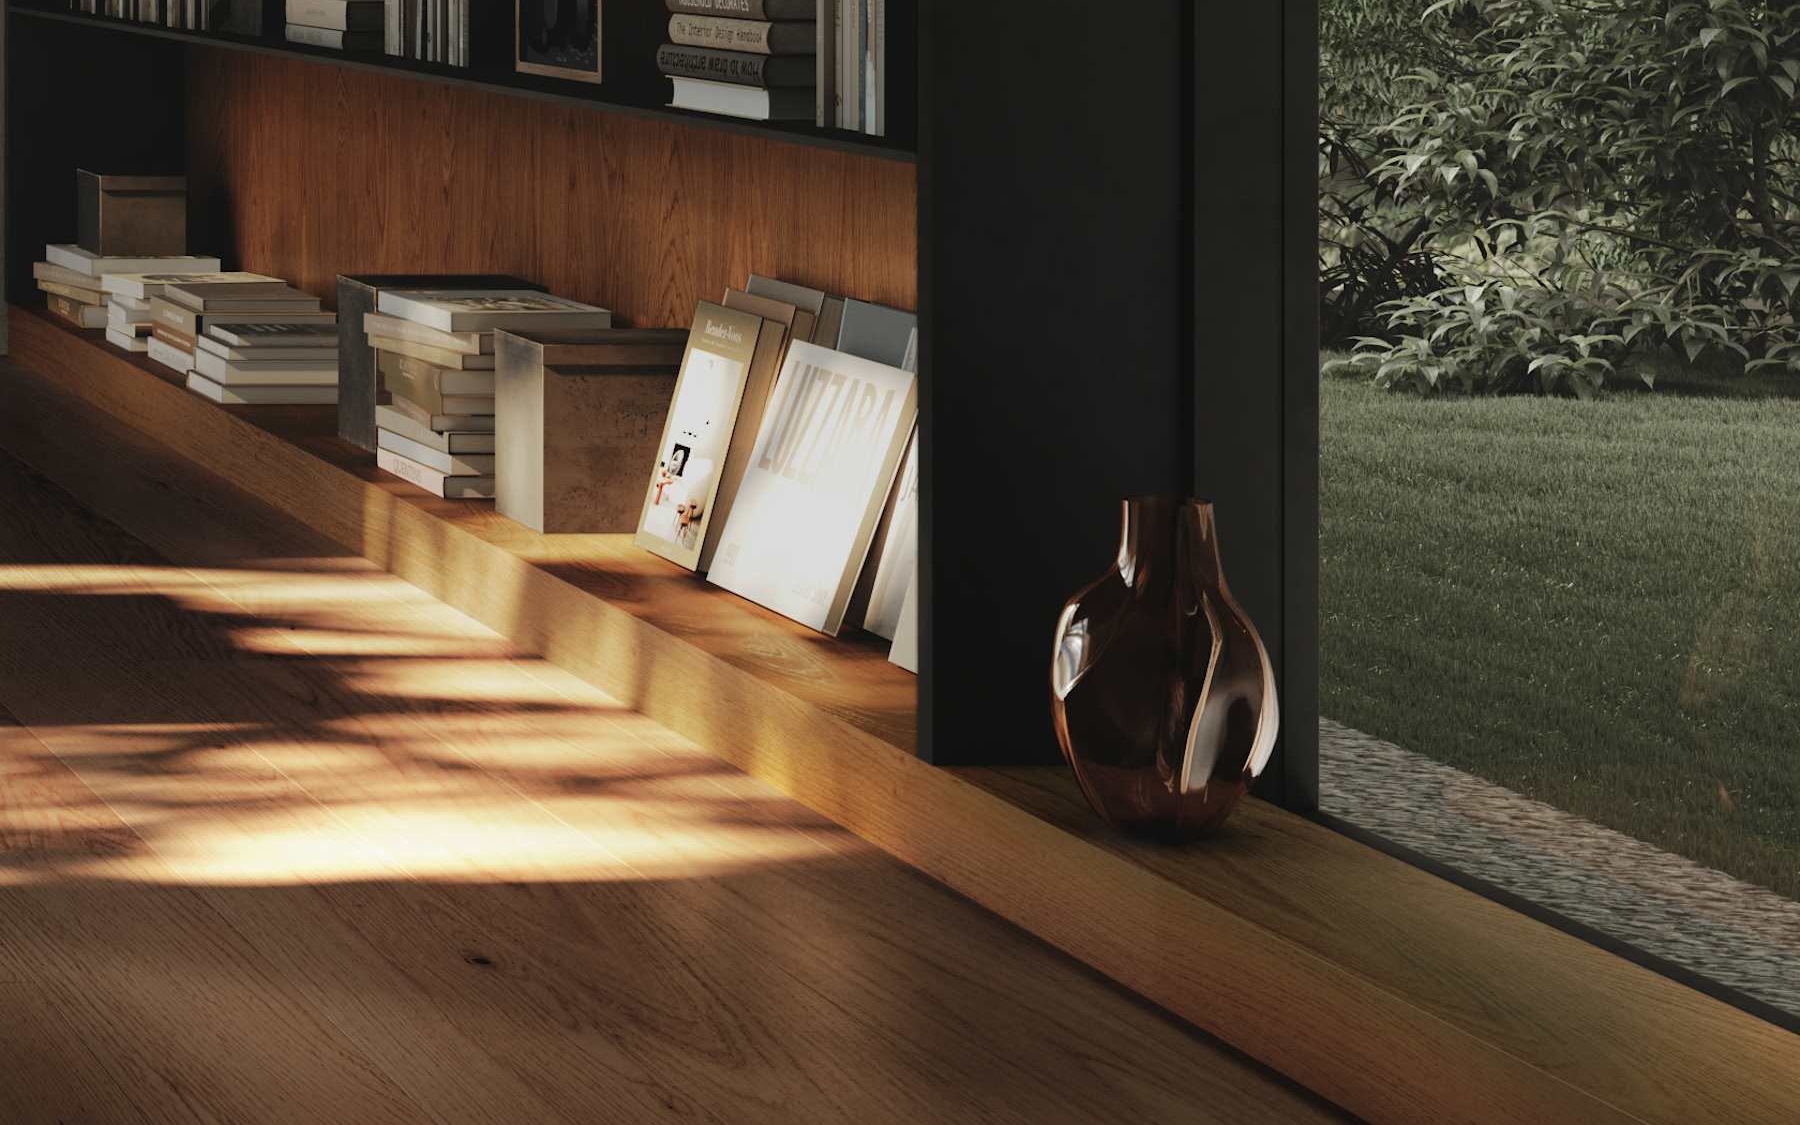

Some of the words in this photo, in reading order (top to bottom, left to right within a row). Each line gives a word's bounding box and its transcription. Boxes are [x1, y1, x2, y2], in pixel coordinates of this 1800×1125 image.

[676, 21, 686, 33] The
[688, 23, 712, 38] Interior
[715, 25, 734, 44] Design
[736, 27, 762, 44] Handbook
